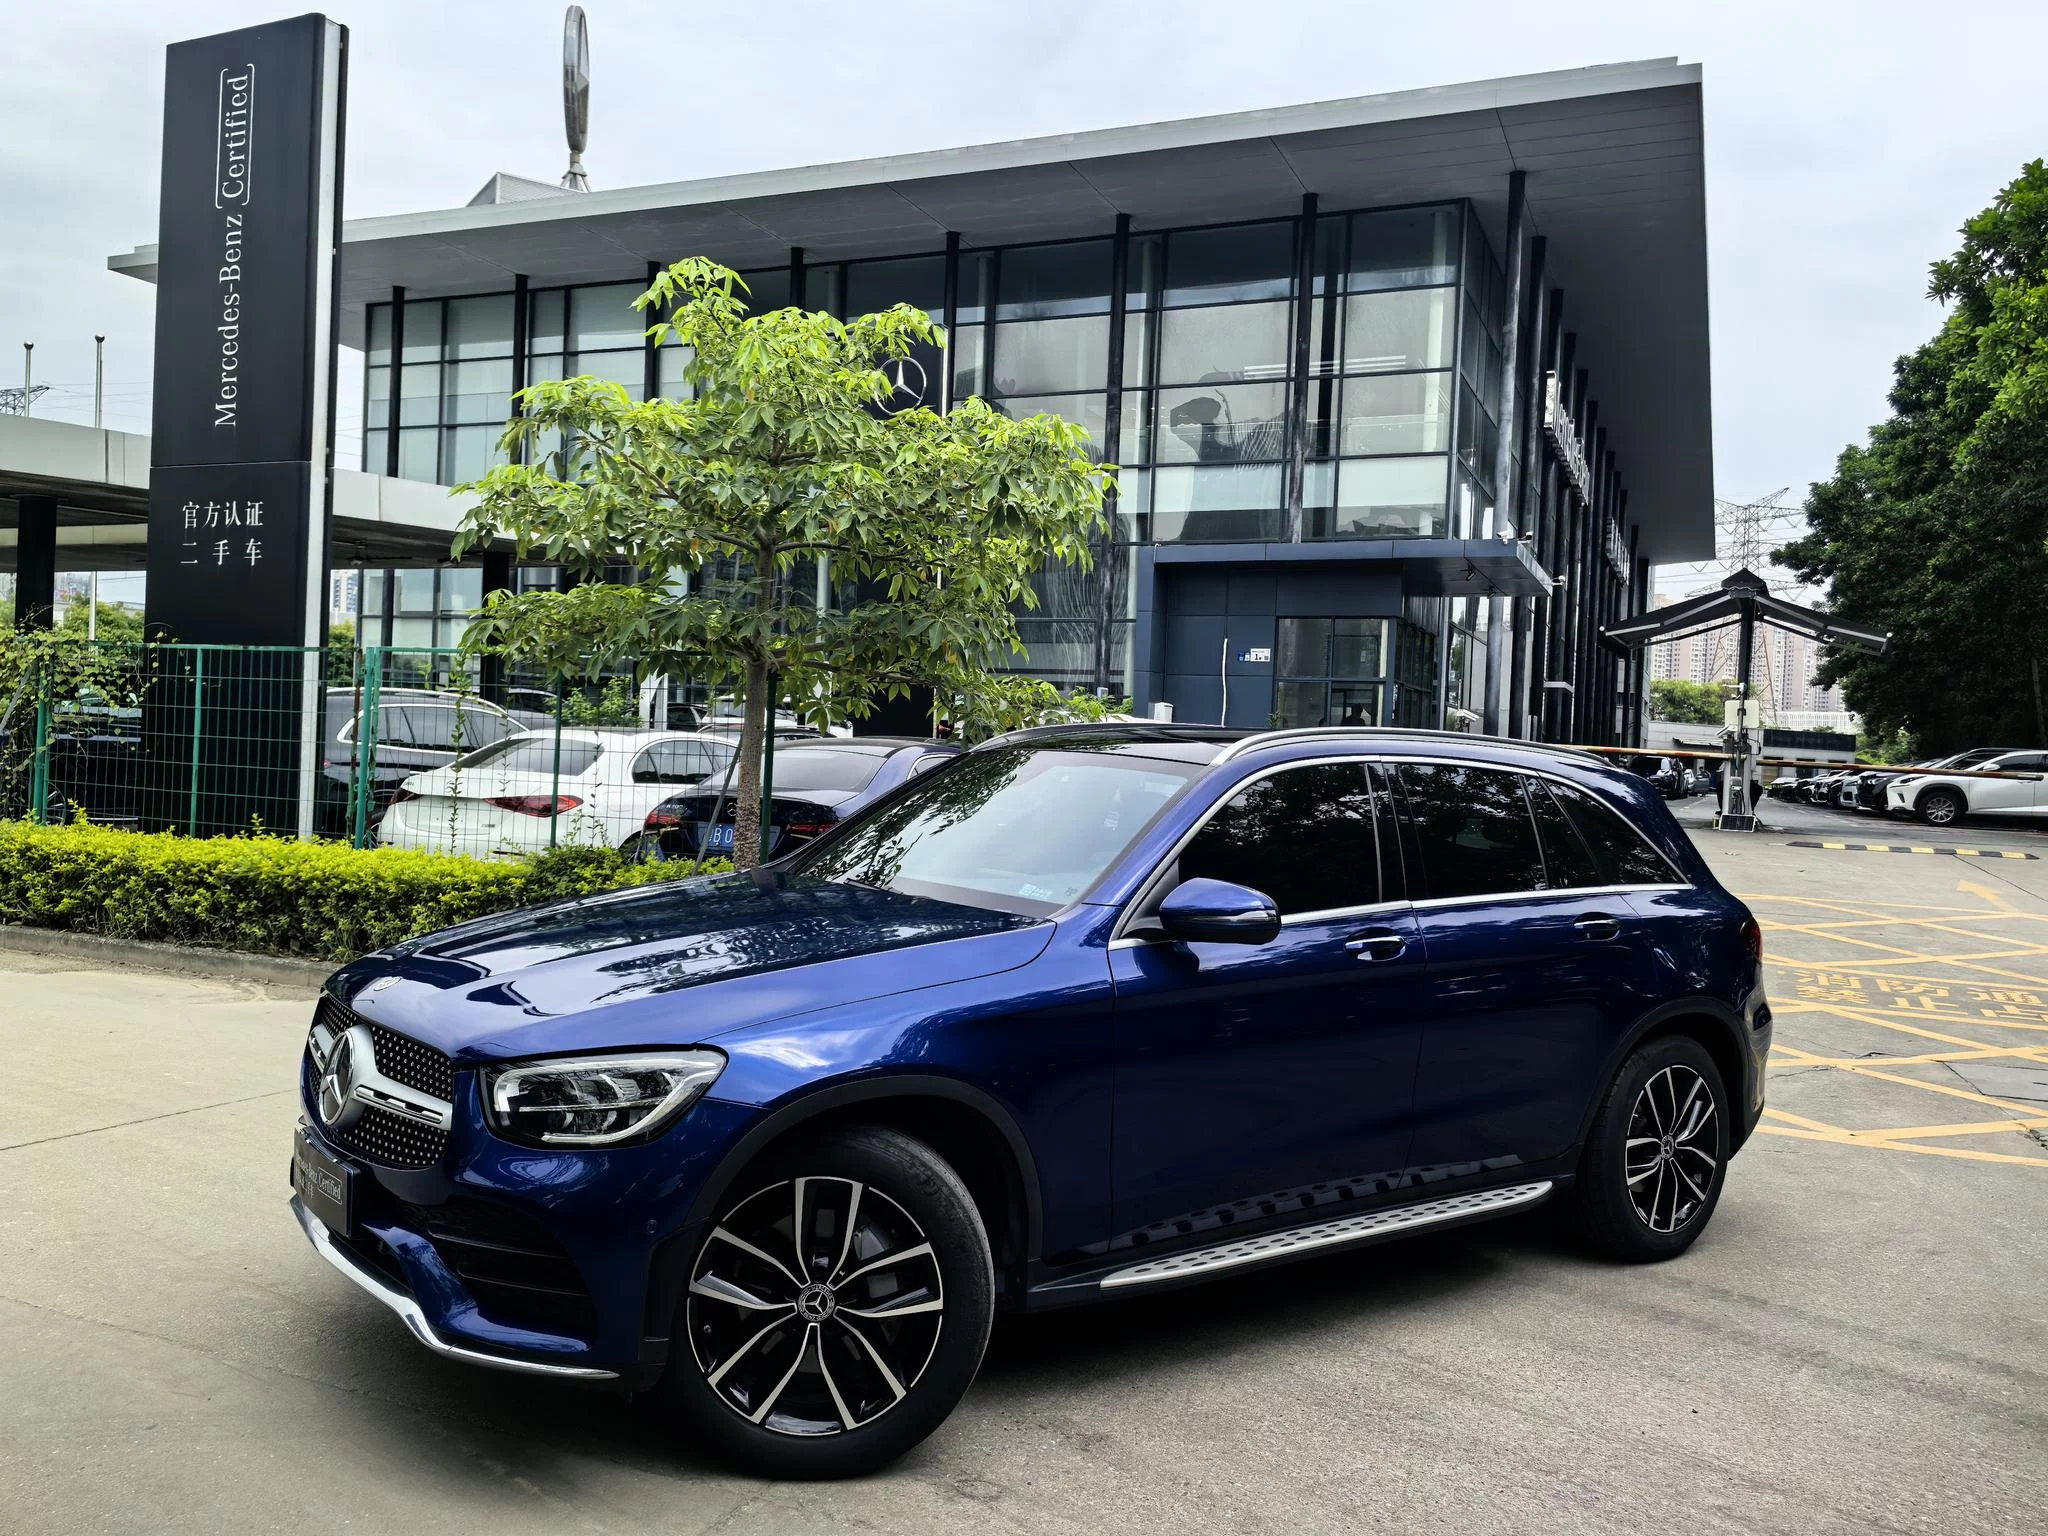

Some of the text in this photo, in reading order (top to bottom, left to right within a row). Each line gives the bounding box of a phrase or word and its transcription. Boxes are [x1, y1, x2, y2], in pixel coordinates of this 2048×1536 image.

[214, 74, 248, 427] Mercedes-Benz Certified
[182, 500, 264, 529] 官方认证
[180, 538, 263, 566] 二手车
[318, 1172, 341, 1200] Certified
